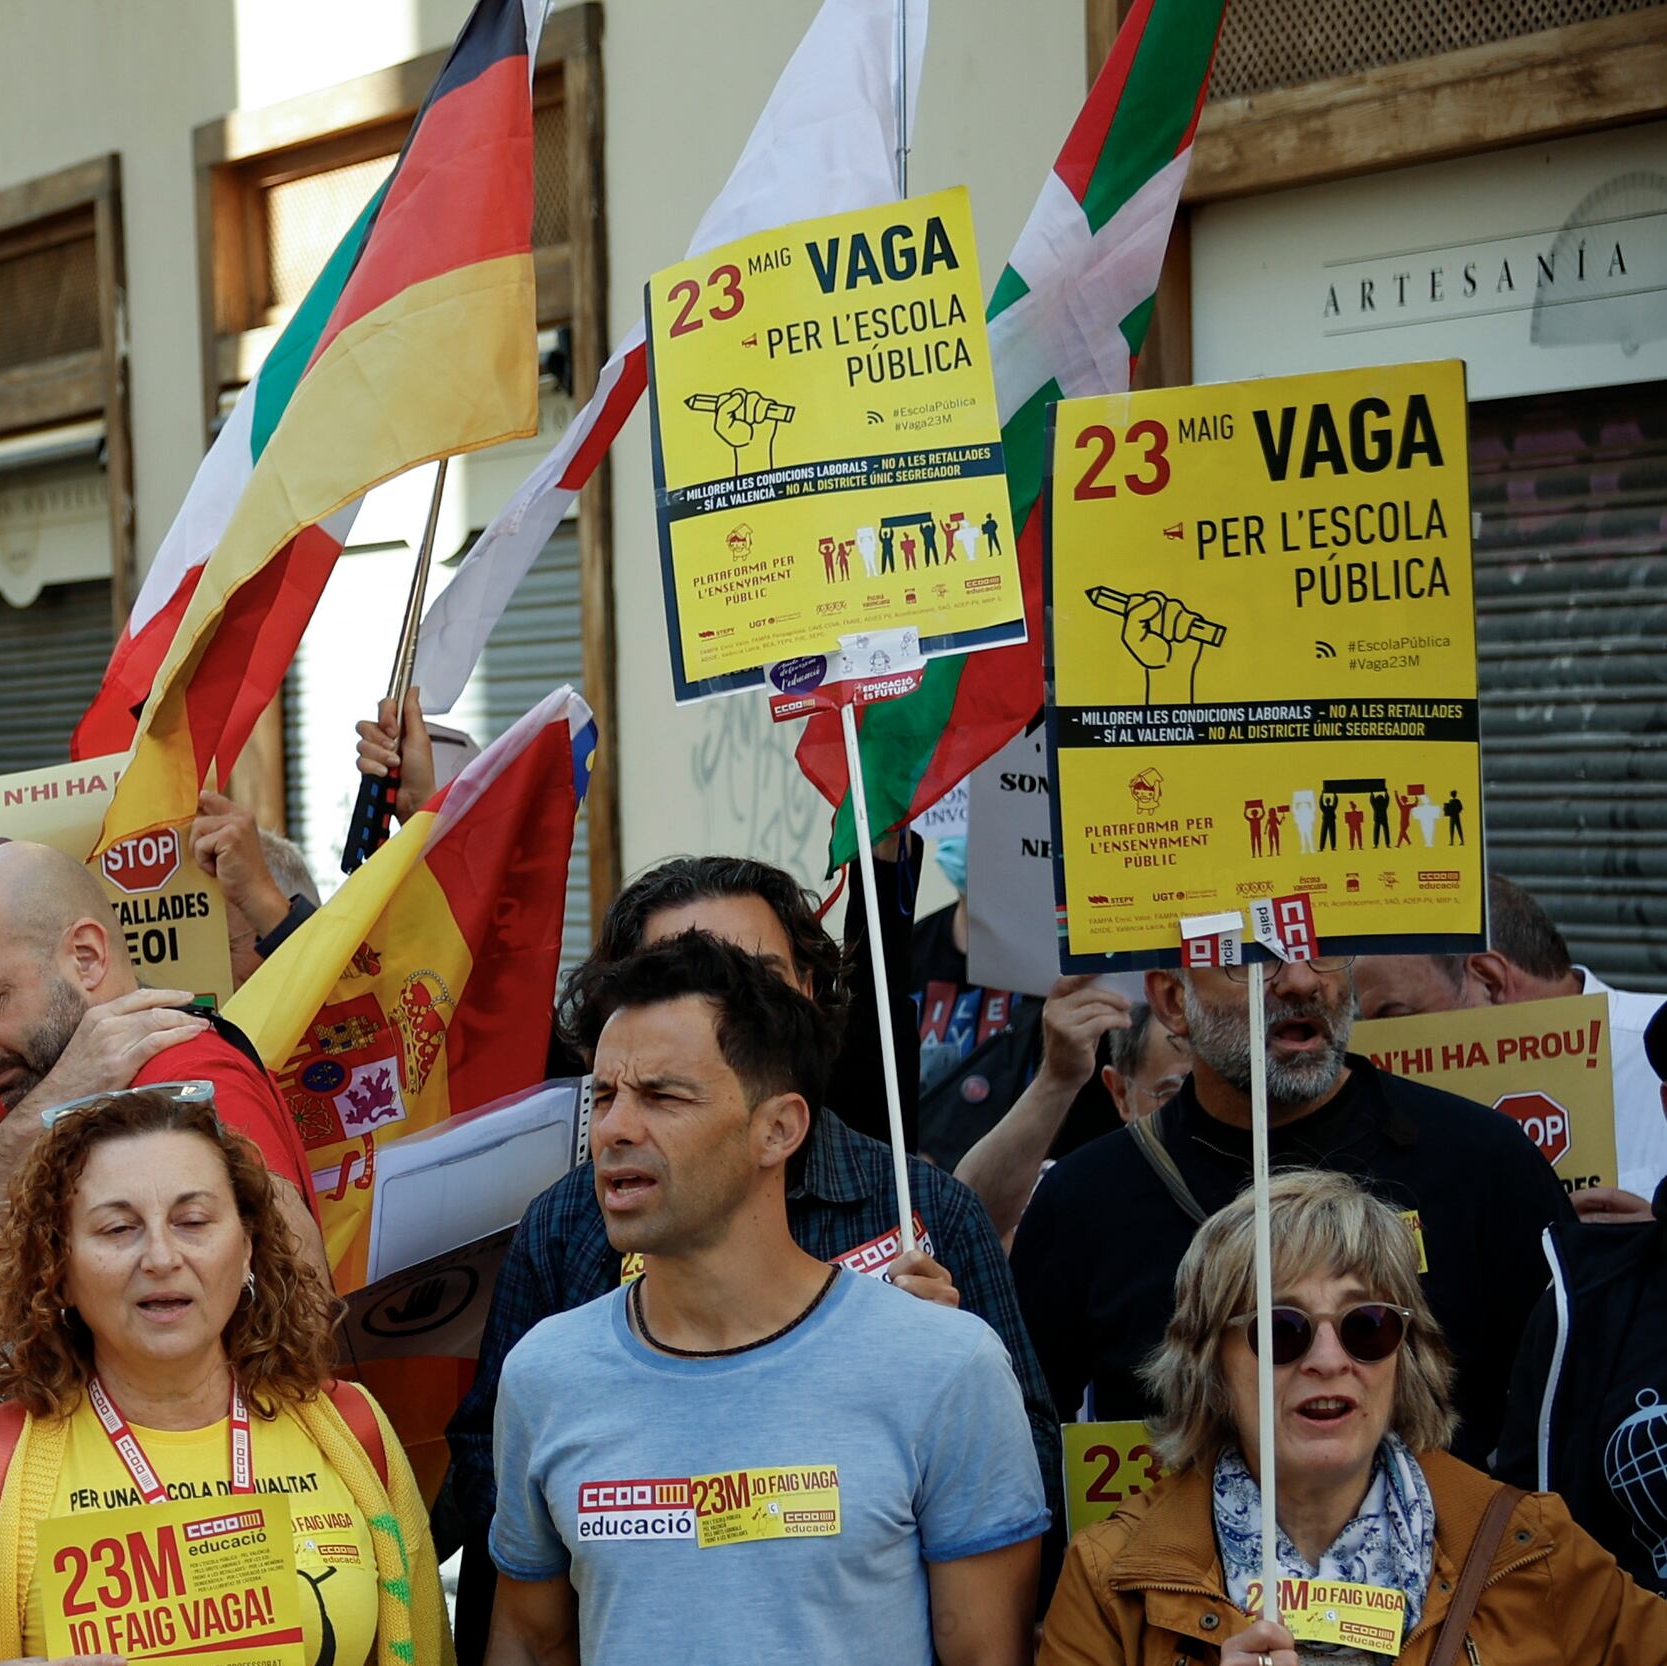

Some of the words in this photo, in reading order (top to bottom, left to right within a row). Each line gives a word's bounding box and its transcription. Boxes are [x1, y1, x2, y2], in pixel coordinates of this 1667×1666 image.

[667, 263, 746, 339] 23
[747, 246, 793, 277] MAIG
[805, 216, 960, 294] VAGA
[1323, 238, 1628, 318] ARTESANÍA
[766, 319, 823, 359] PER
[832, 293, 968, 347] L'ESCOLA
[846, 336, 973, 388] PÚBLICA
[892, 396, 977, 419] #EscolaPública
[894, 413, 954, 432] #Vaga23M
[1074, 419, 1171, 501] 23
[1178, 413, 1235, 444] MAIG
[1252, 393, 1444, 482] VAGA
[686, 481, 735, 501] MILLOREM
[756, 468, 815, 488] CONDICIONS
[817, 460, 869, 478] LABORALS
[908, 453, 927, 467] LES
[928, 447, 992, 465] RETALLADES
[730, 485, 776, 507] VALENCIÀ
[817, 475, 868, 493] DISTRICTE
[895, 464, 961, 483] SEGREGADOR
[1196, 514, 1266, 561] PER
[1280, 498, 1448, 553] L'ESCOLA
[692, 560, 767, 588] PLATAFORMA
[1294, 552, 1451, 608] PÚBLICA
[724, 586, 768, 607] PÚBLIC
[1347, 634, 1451, 653] #EscolaPública
[1348, 654, 1421, 671] #Vaga23M
[1081, 709, 1144, 727] MILLOREM
[1146, 708, 1170, 725] LES
[1171, 706, 1246, 725] CONDICIONS
[1248, 704, 1312, 722] LABORALS
[1328, 705, 1347, 719] NO
[1361, 703, 1385, 719] LES
[1386, 703, 1464, 719] RETALLADES
[1119, 727, 1135, 743] AL
[1137, 723, 1195, 743] VALENCIÀ
[1207, 726, 1226, 741] NO
[1228, 725, 1245, 740] AL
[1247, 723, 1311, 740] DISTRICTE
[1313, 719, 1343, 737] ÚNIC
[1344, 721, 1426, 737] SEGREGADOR
[67, 775, 108, 796] HA
[1084, 821, 1180, 839] PLATAFORMA
[1186, 816, 1215, 831] PER
[105, 834, 174, 872] STOP
[1089, 833, 1209, 855] L'ENSENYAMENT
[1124, 851, 1177, 869] PÚBLIC
[1152, 891, 1175, 902] UGT
[1418, 881, 1460, 890] educació
[1441, 1041, 1491, 1072] HA
[1496, 1020, 1602, 1069] PROU!
[69, 1487, 101, 1512] PER
[104, 1487, 141, 1509] UNA
[691, 1472, 751, 1518] 23M
[751, 1479, 767, 1497] JO
[769, 1473, 799, 1494] FAIG
[802, 1470, 839, 1489] VAGA
[295, 1515, 323, 1531] FAIG
[324, 1512, 354, 1530] VAGA
[579, 1511, 692, 1537] educació
[784, 1523, 836, 1534] educació
[188, 1529, 267, 1558] educació
[53, 1524, 187, 1618] 23M
[322, 1556, 362, 1566] educació
[1310, 1587, 1327, 1603] JO
[1330, 1587, 1363, 1606] FAIG
[1366, 1590, 1404, 1612] VAGA
[106, 1604, 177, 1656] FAIG
[178, 1585, 275, 1642] VAGA!
[1339, 1634, 1393, 1651] educació
